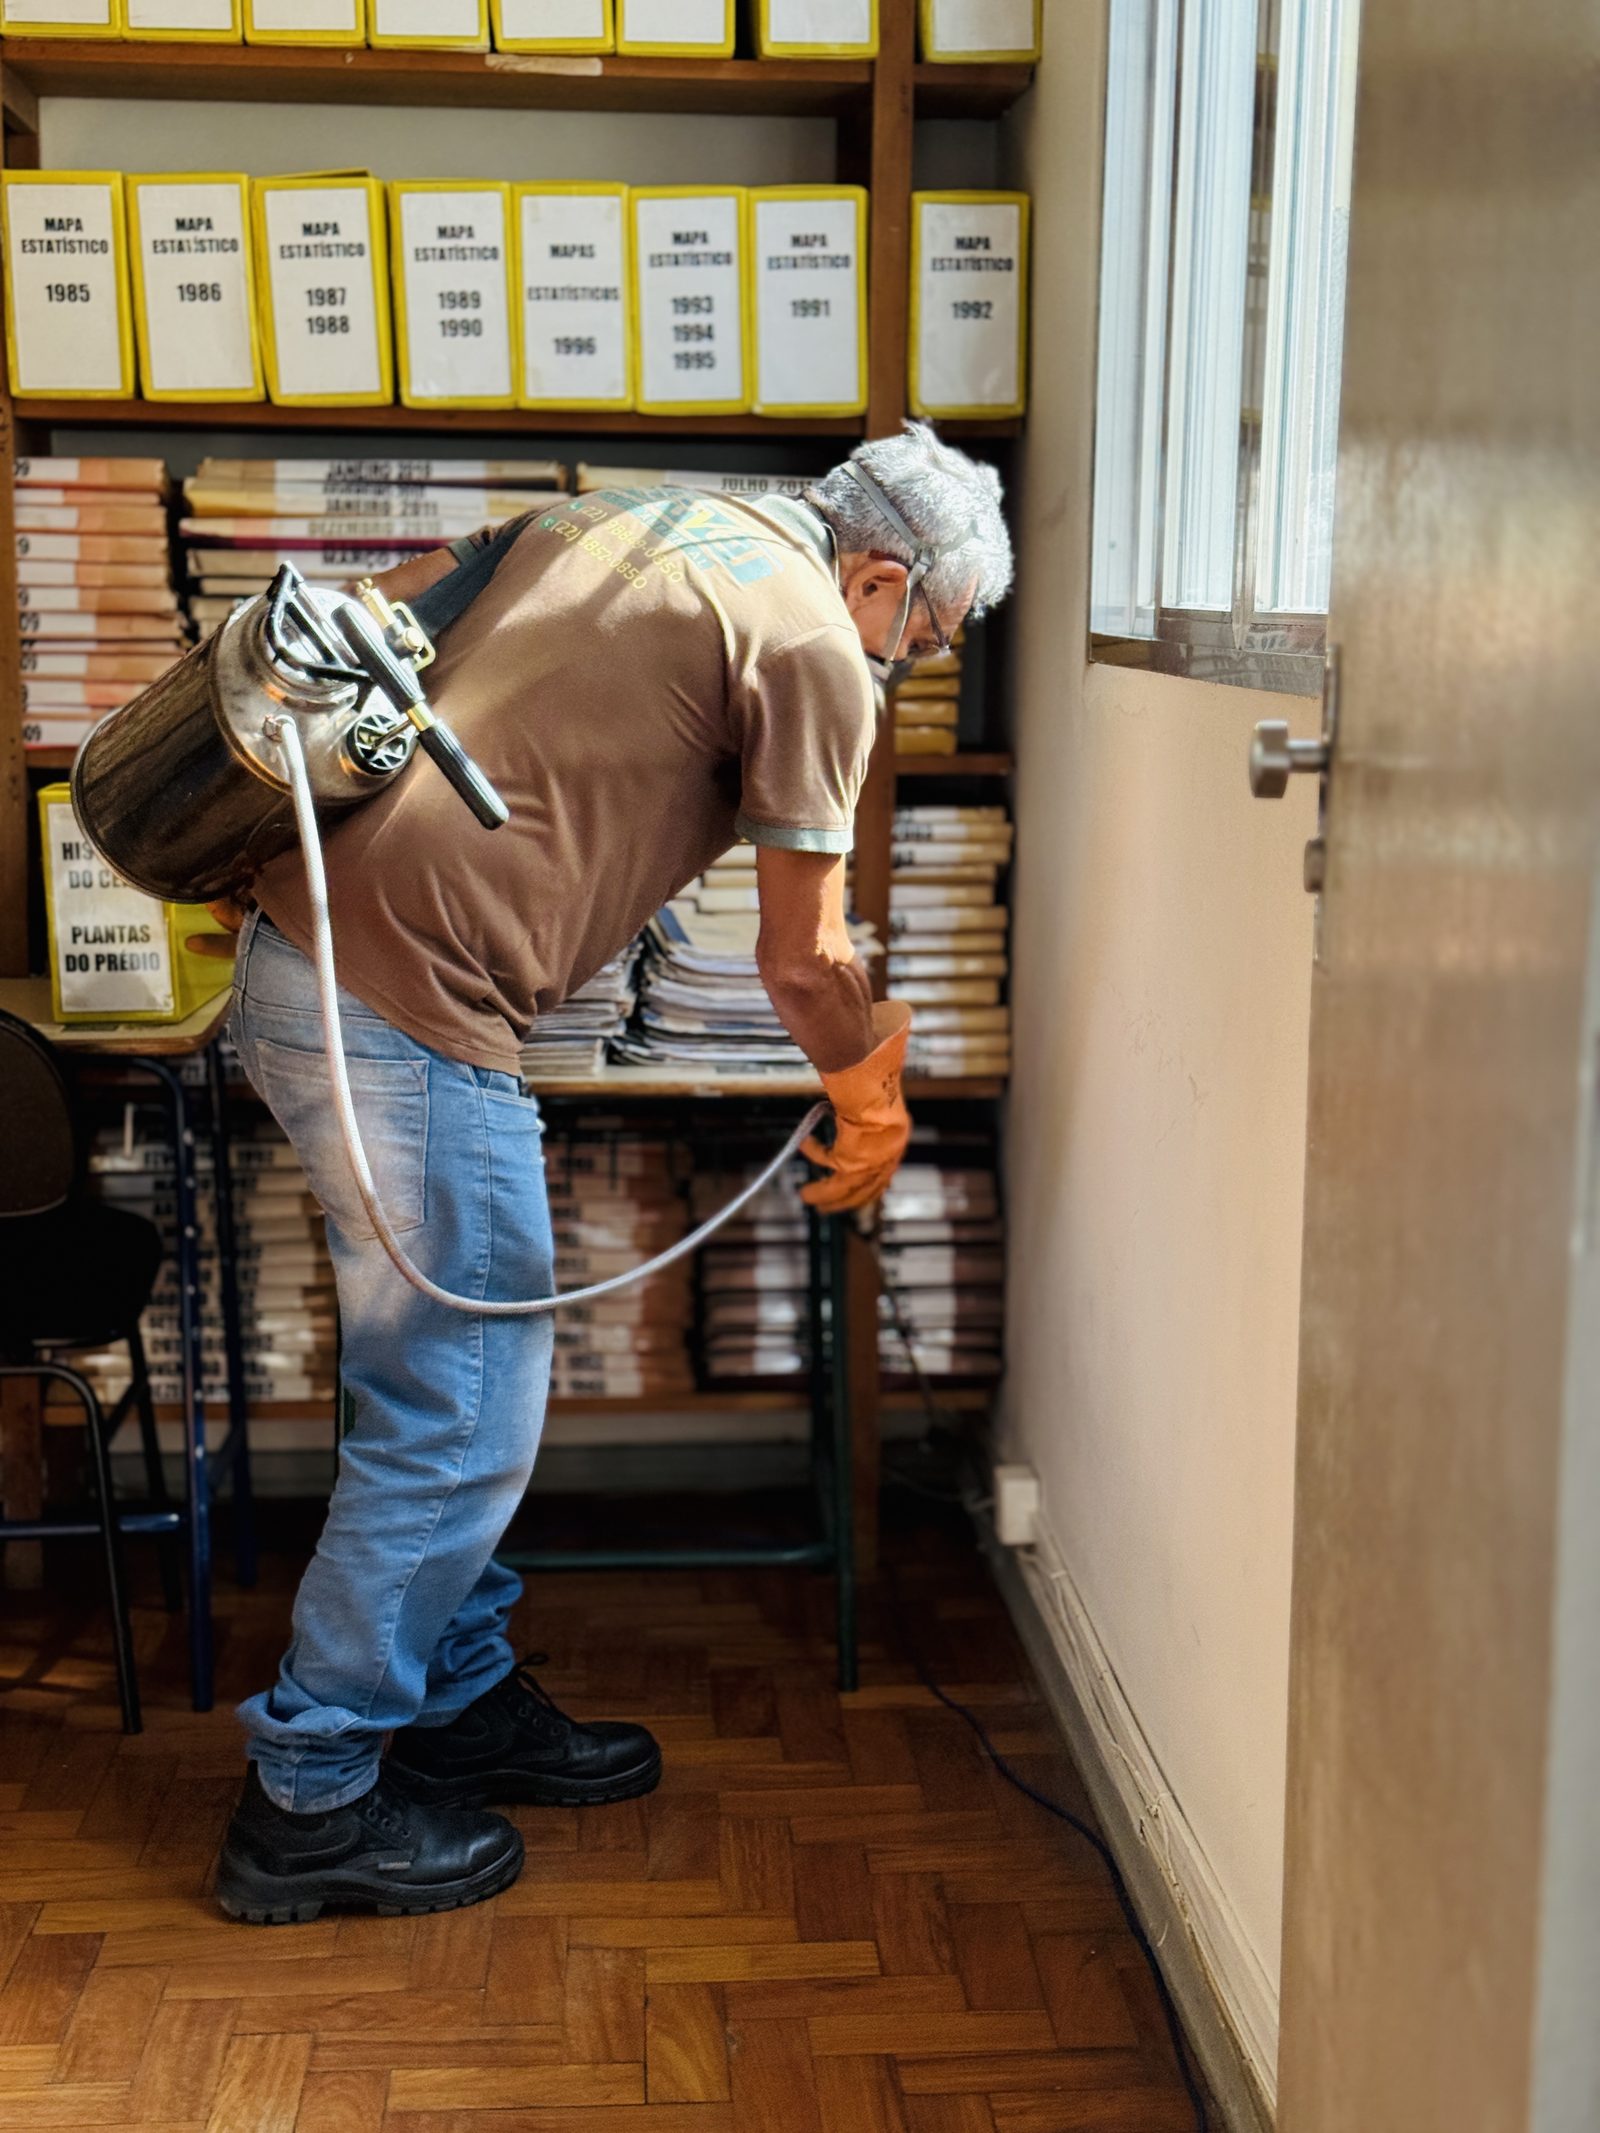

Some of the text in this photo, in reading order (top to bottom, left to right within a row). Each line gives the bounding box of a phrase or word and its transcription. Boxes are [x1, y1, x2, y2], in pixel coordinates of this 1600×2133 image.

[44, 217, 84, 232] MAPA
[175, 217, 214, 232] MAPA
[301, 221, 340, 237] MAPA
[437, 225, 475, 240] MAPA
[20, 237, 109, 255] ESTATÍSTICO
[672, 231, 709, 246] MAPA
[790, 233, 828, 248] MAPA
[955, 236, 992, 251] MAPA
[279, 242, 366, 260] ESTATÍSTICO
[414, 245, 500, 262] ESTATÍSTICO
[549, 244, 595, 259] MAPAS
[45, 283, 91, 303] 1985
[177, 282, 222, 303] 1986
[305, 287, 347, 307] 1987
[437, 290, 482, 310] 1989
[671, 295, 714, 315] 1993
[791, 298, 830, 318] 1991
[952, 300, 994, 320] 1992
[306, 314, 350, 335] 1988
[439, 318, 483, 338] 1990
[673, 323, 715, 343] 1994
[553, 336, 597, 356] 1996
[673, 351, 716, 371] 1995
[720, 477, 769, 493] JULHO
[550, 520, 583, 543] (22)
[68, 869, 93, 889] DO
[71, 925, 151, 946] PLANTAS
[64, 950, 161, 973] DO PRÉDIO
